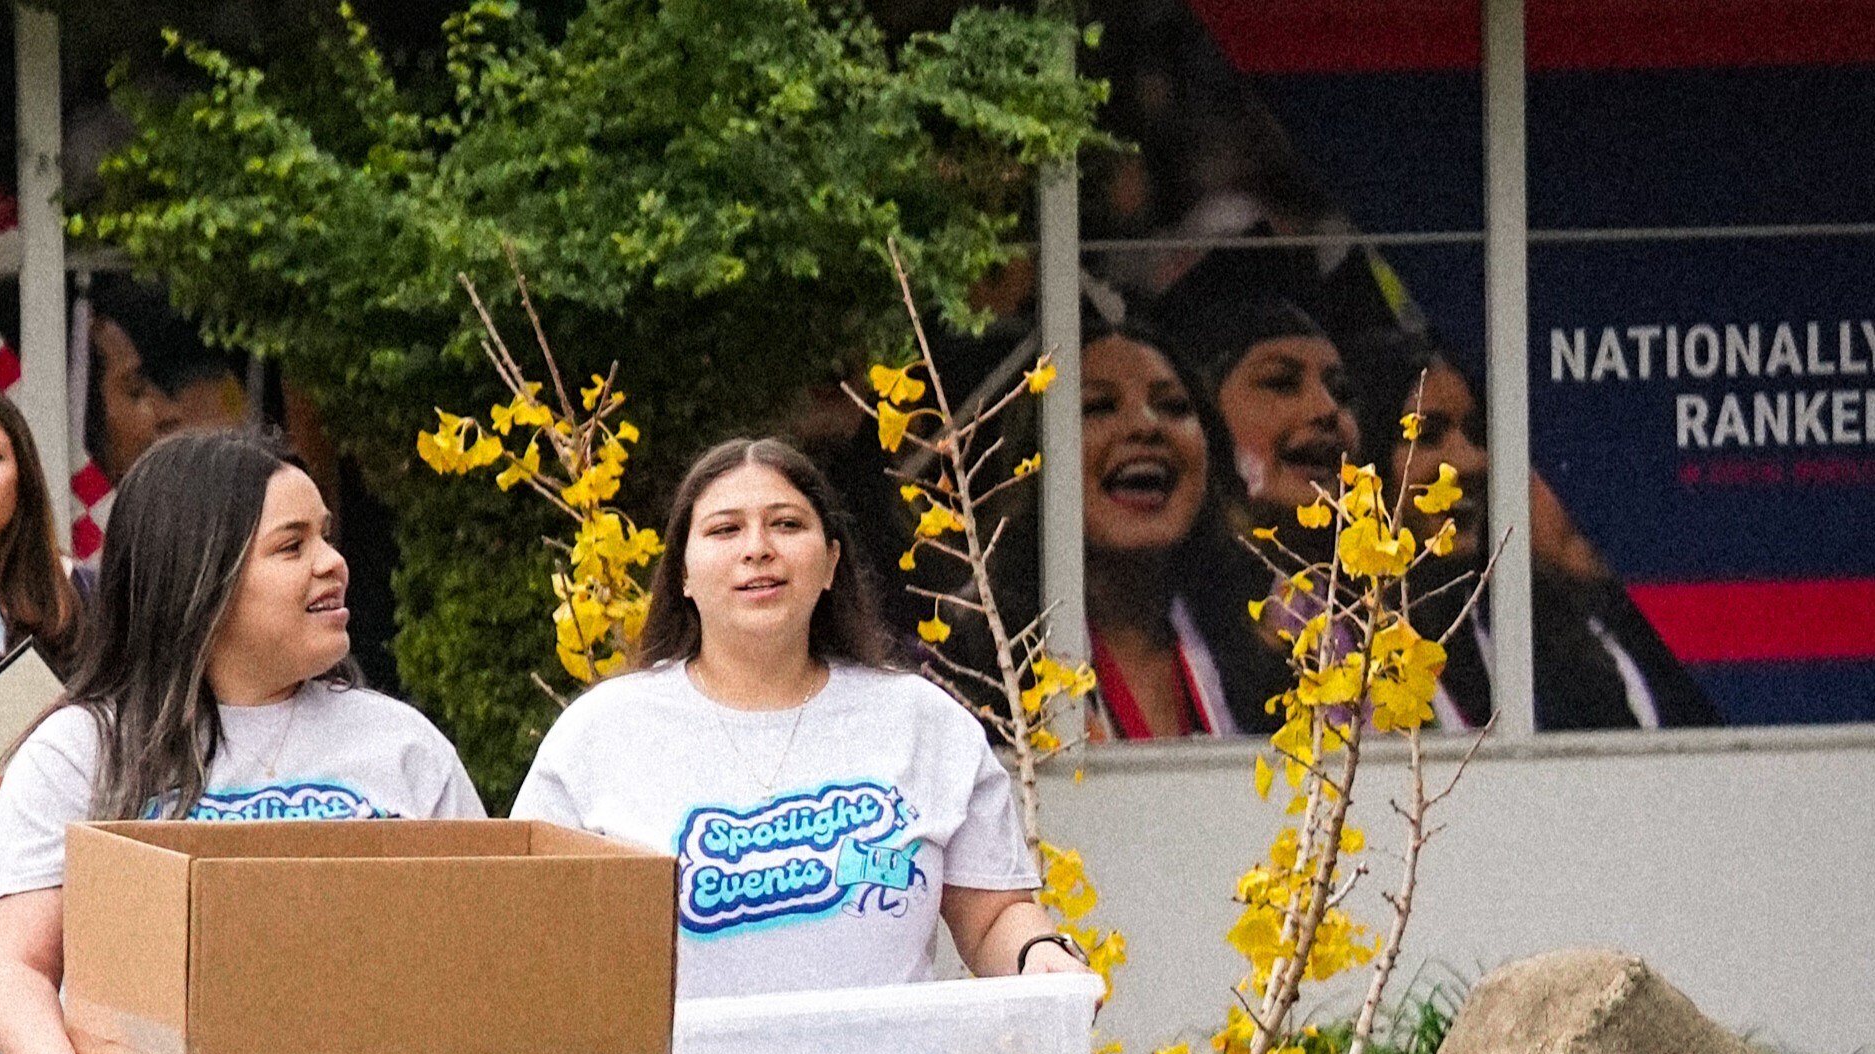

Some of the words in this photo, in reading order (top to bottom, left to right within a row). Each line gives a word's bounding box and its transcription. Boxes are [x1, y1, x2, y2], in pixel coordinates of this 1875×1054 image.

[187, 796, 354, 821] potlight
[701, 793, 881, 858] Spotlight
[692, 857, 827, 909] Events
